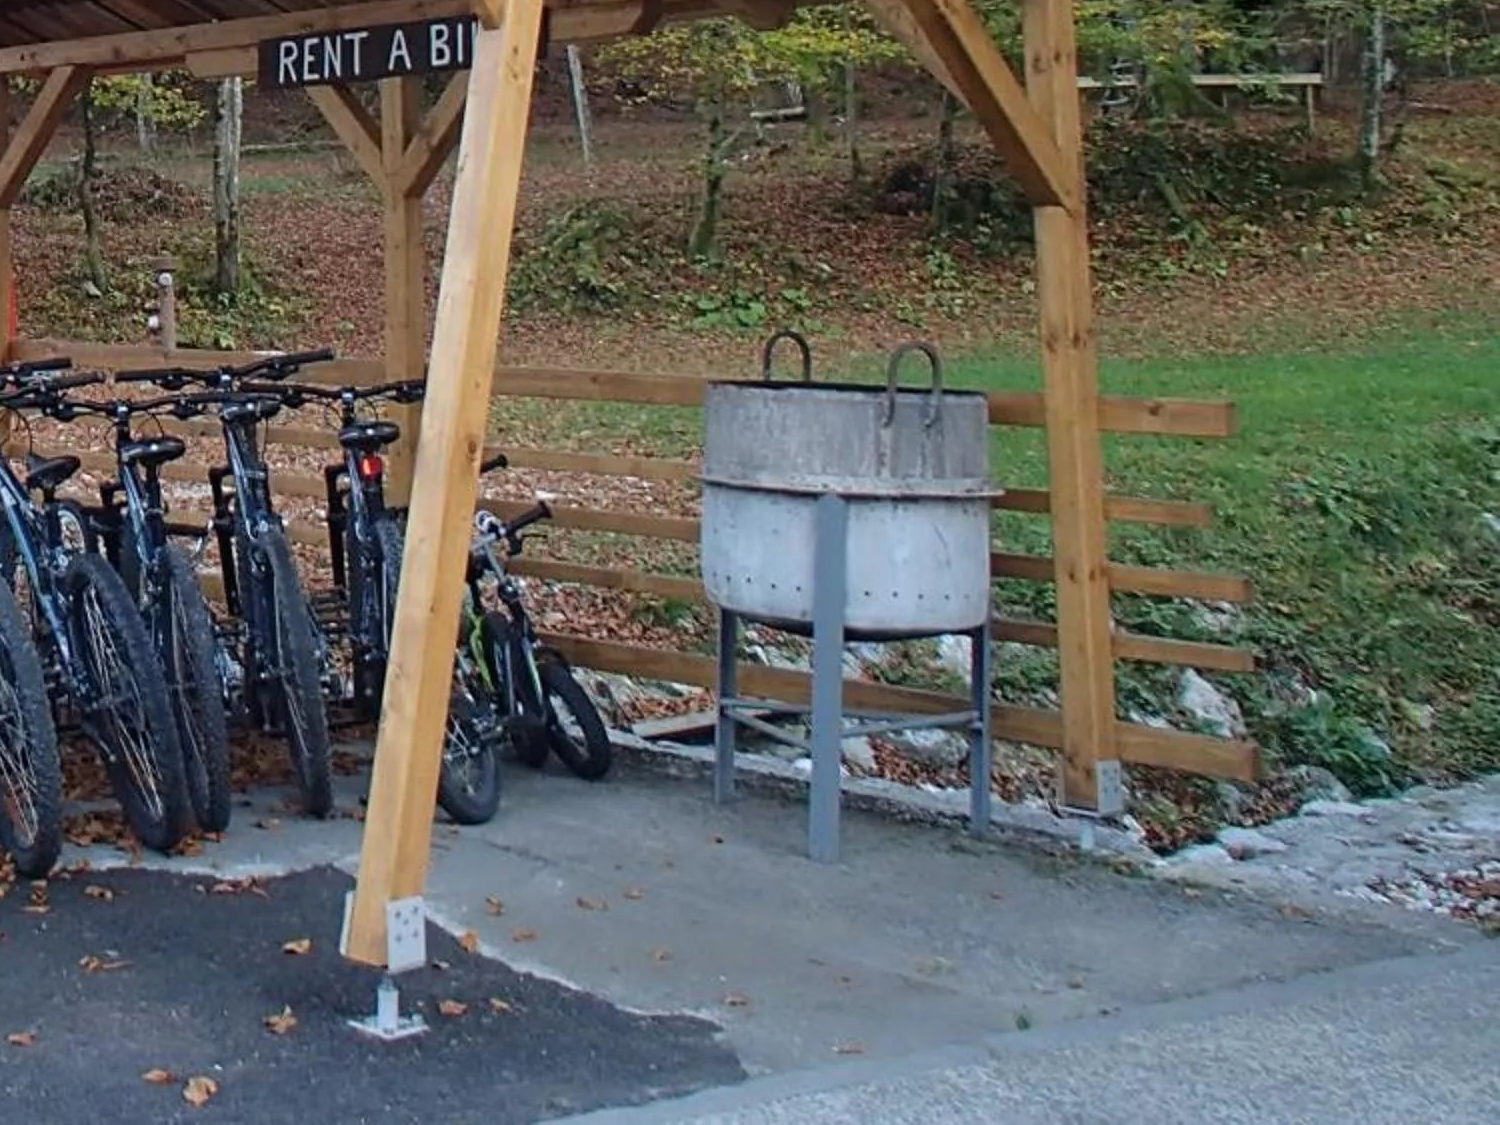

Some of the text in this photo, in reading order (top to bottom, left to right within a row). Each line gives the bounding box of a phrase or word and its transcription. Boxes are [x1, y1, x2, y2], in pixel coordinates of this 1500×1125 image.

[278, 21, 480, 84] RENT A BI
